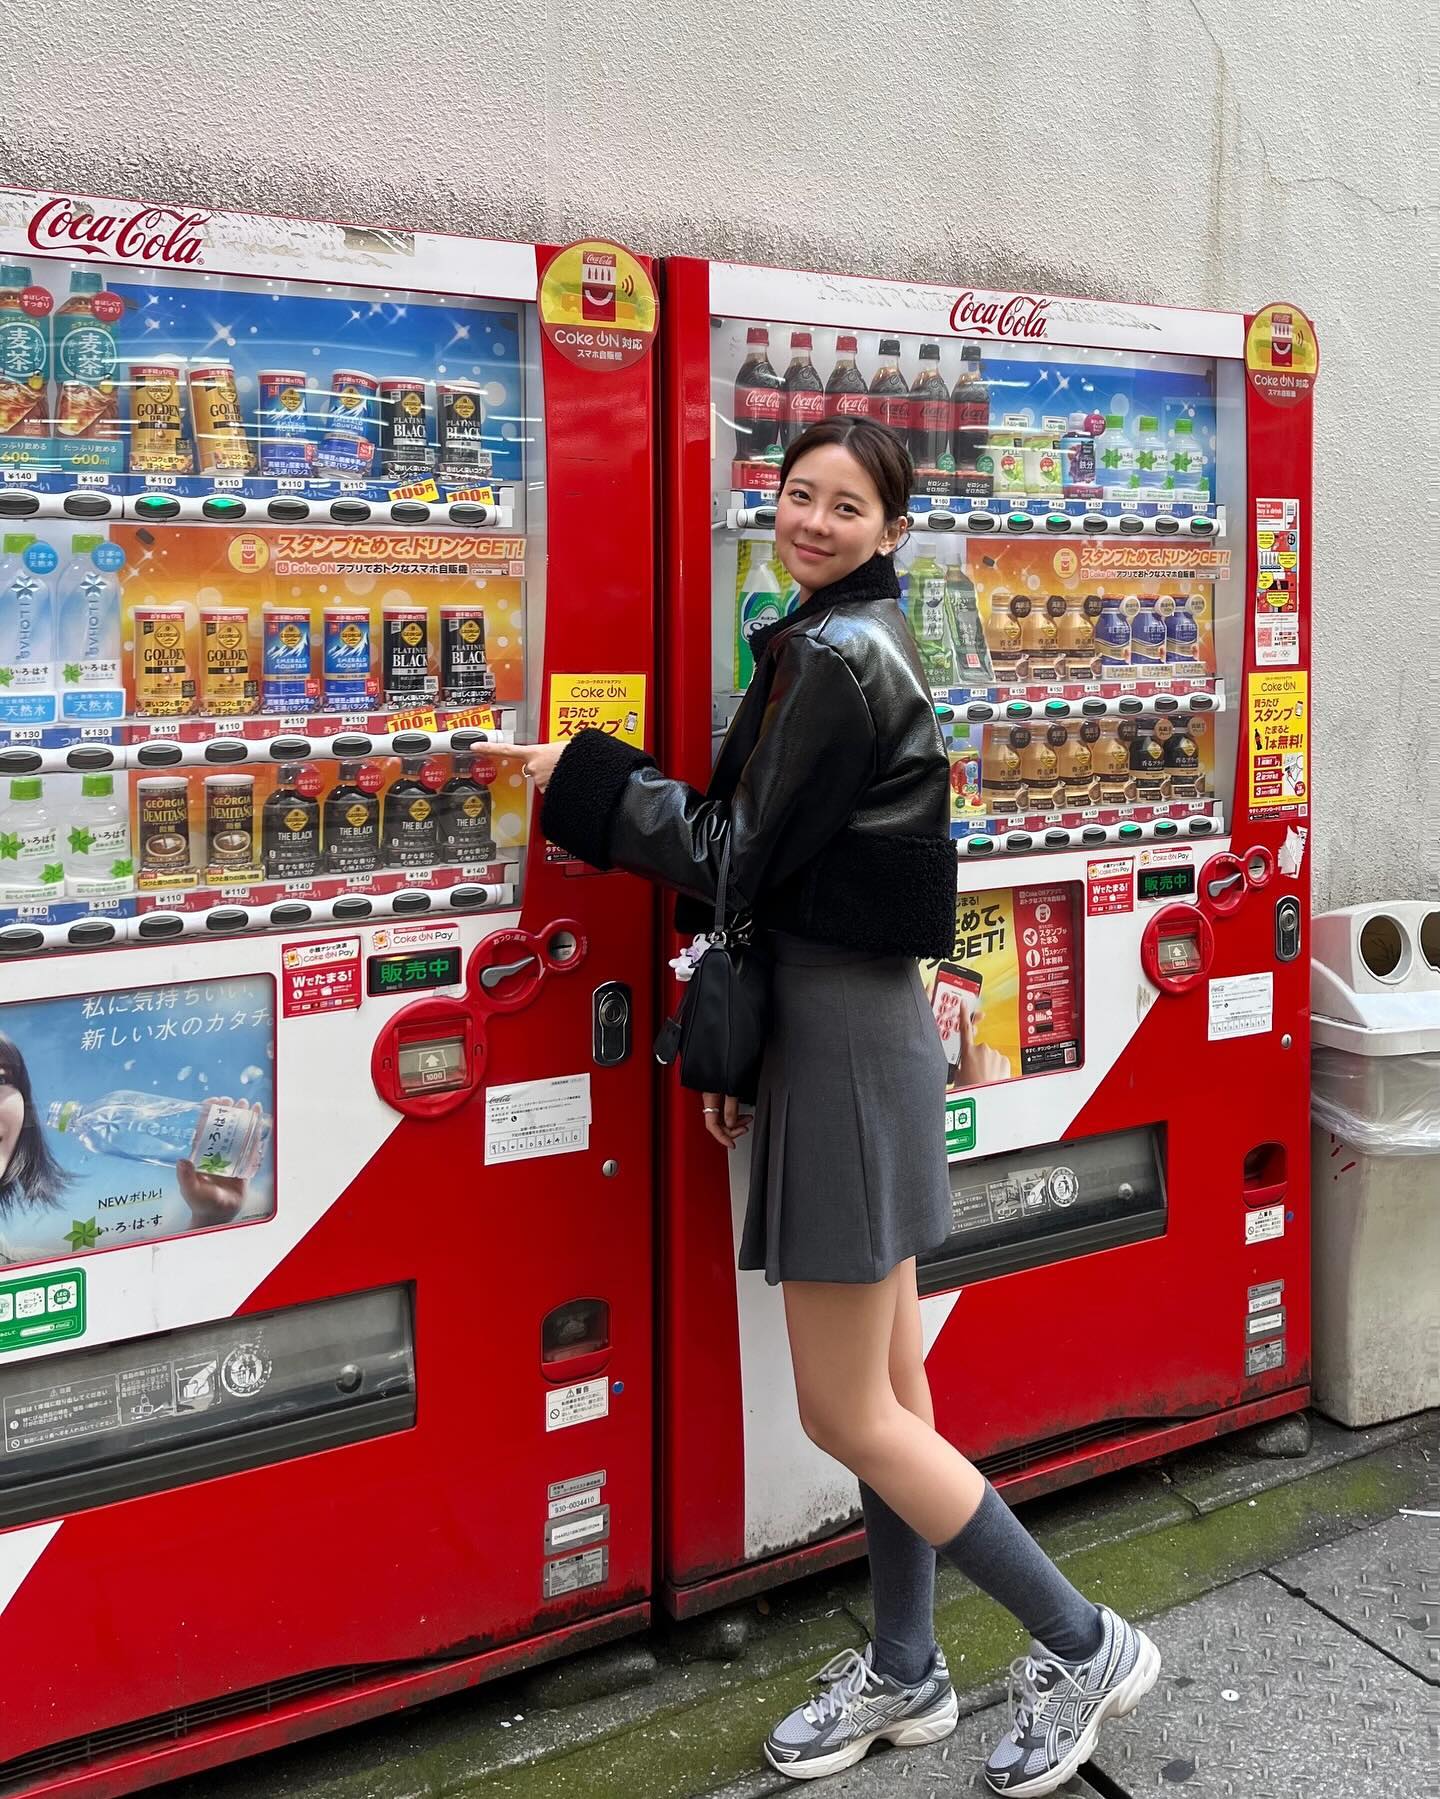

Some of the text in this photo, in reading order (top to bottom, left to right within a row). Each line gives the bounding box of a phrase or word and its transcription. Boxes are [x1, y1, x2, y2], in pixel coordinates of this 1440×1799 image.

[28, 198, 213, 264] Coca-Cola
[587, 254, 612, 265] Coca-Cola
[950, 292, 1053, 338] Coca-Cola
[555, 330, 643, 350] Coke ON 対応
[6, 328, 32, 371] 麦茶
[79, 333, 103, 375] 麦茶
[577, 349, 623, 361] スマホ自販機
[1254, 375, 1279, 386] Coke
[1280, 375, 1294, 387] ON
[8, 473, 32, 481] ¥140
[81, 476, 105, 484] ¥140
[150, 477, 173, 485] ¥110
[218, 479, 240, 487] ¥110
[391, 484, 434, 500] 100円
[449, 490, 491, 501] 100円
[291, 563, 318, 574] Coke
[320, 562, 335, 573] ON
[571, 684, 627, 698] Coke ON
[1261, 680, 1296, 692] Coke ON
[75, 700, 114, 714] 天然水
[1254, 698, 1279, 708] 買うたび
[7, 703, 46, 717] 天然水
[559, 707, 599, 718] 買うたび
[1253, 708, 1293, 723] スタンプ
[390, 716, 433, 731] 100円
[450, 714, 491, 729] 100円
[14, 730, 40, 738] ¥130
[84, 728, 109, 736] ¥130
[154, 725, 176, 733] ¥110
[1264, 725, 1290, 735] たまると
[1264, 734, 1303, 750] 1本無料!
[1256, 772, 1261, 781] 2
[1256, 787, 1261, 796] 3
[402, 820, 434, 830] THE BLACK
[456, 817, 487, 827] THE BLACK
[278, 830, 312, 841] THE BLACK
[340, 826, 373, 836] THE BLACK
[1178, 852, 1190, 860] Pay
[351, 875, 370, 883] ¥140
[409, 871, 429, 879] ¥140
[1145, 873, 1187, 891] 販売中
[1093, 883, 1128, 895] Wでたまる!
[93, 900, 117, 908] ¥110
[159, 894, 181, 902] ¥110
[393, 931, 453, 944] Coke ON Pay
[1040, 936, 1058, 945] たまる
[303, 949, 354, 963] Coke ON Pay
[380, 958, 449, 984] 販売中
[292, 970, 353, 988] Wでたまる!
[80, 985, 254, 1020] 私に気持ちいい、
[80, 1007, 274, 1051] 新しい水のカタチ。
[426, 1073, 443, 1081] 1000
[97, 1189, 163, 1210] NEWボトル!
